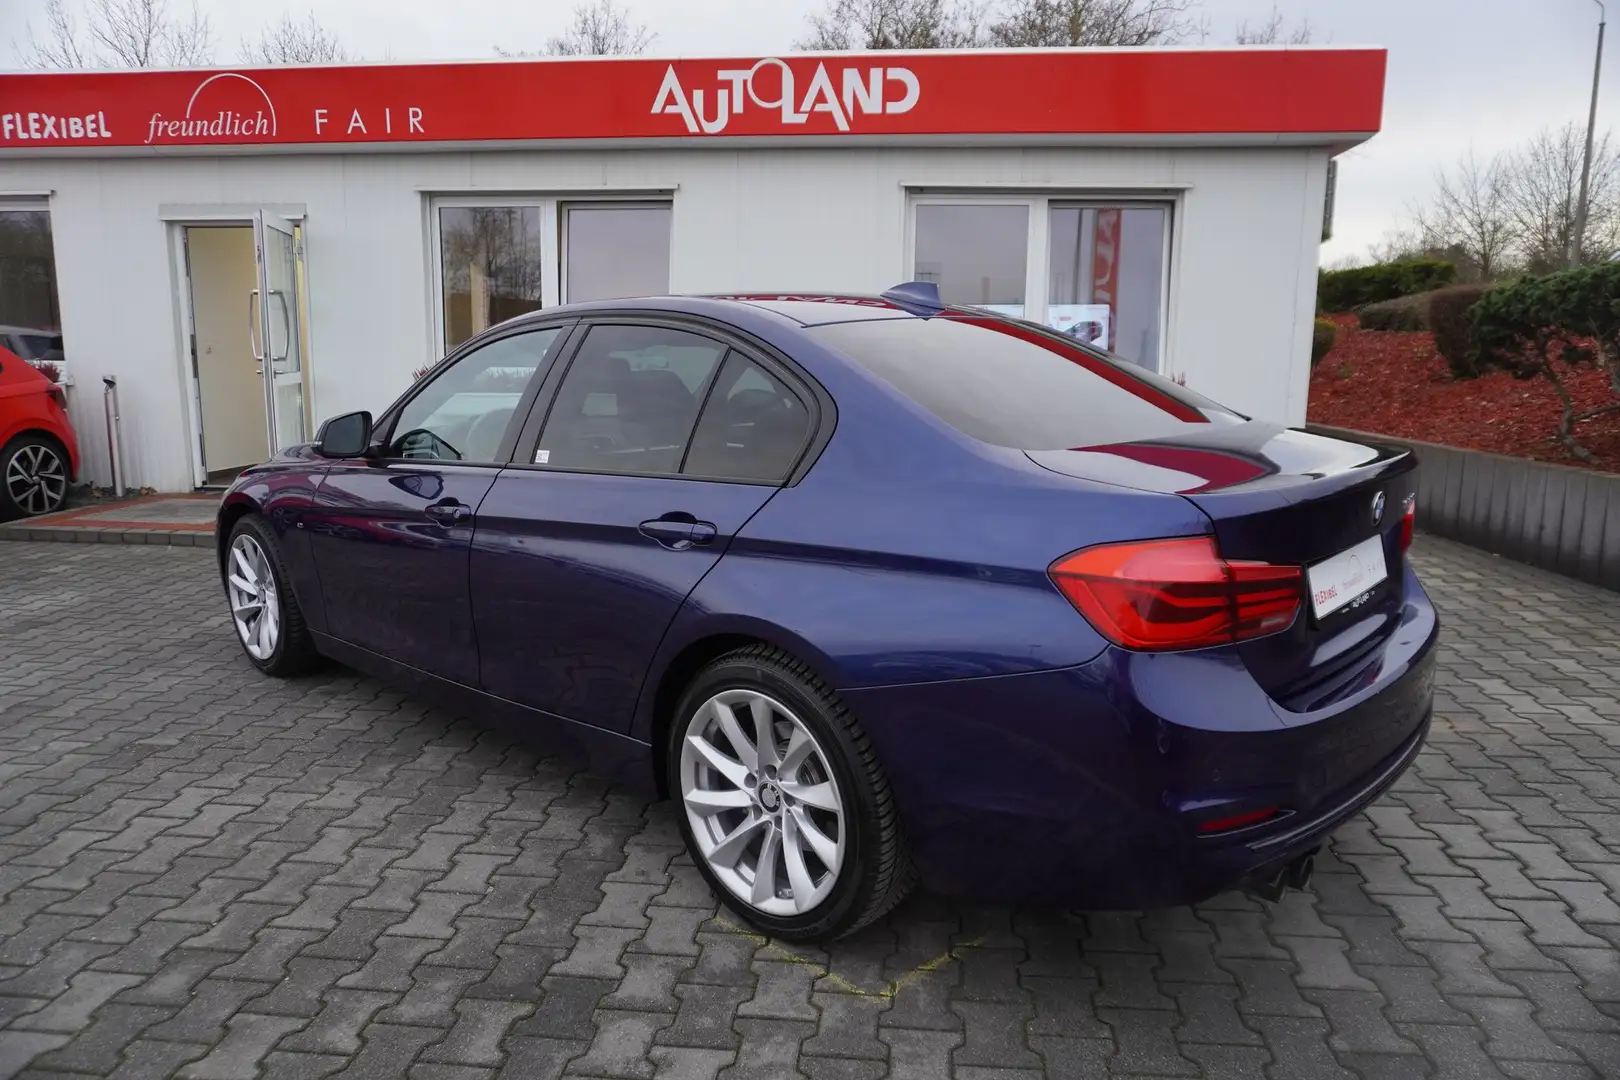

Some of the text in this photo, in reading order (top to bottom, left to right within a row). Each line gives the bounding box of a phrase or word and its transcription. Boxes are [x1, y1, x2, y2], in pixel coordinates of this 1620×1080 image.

[650, 57, 921, 133] AUTOLAND
[2, 111, 112, 140] FLEXIBEL
[144, 110, 269, 144] freundlich
[315, 107, 425, 135] FAIR
